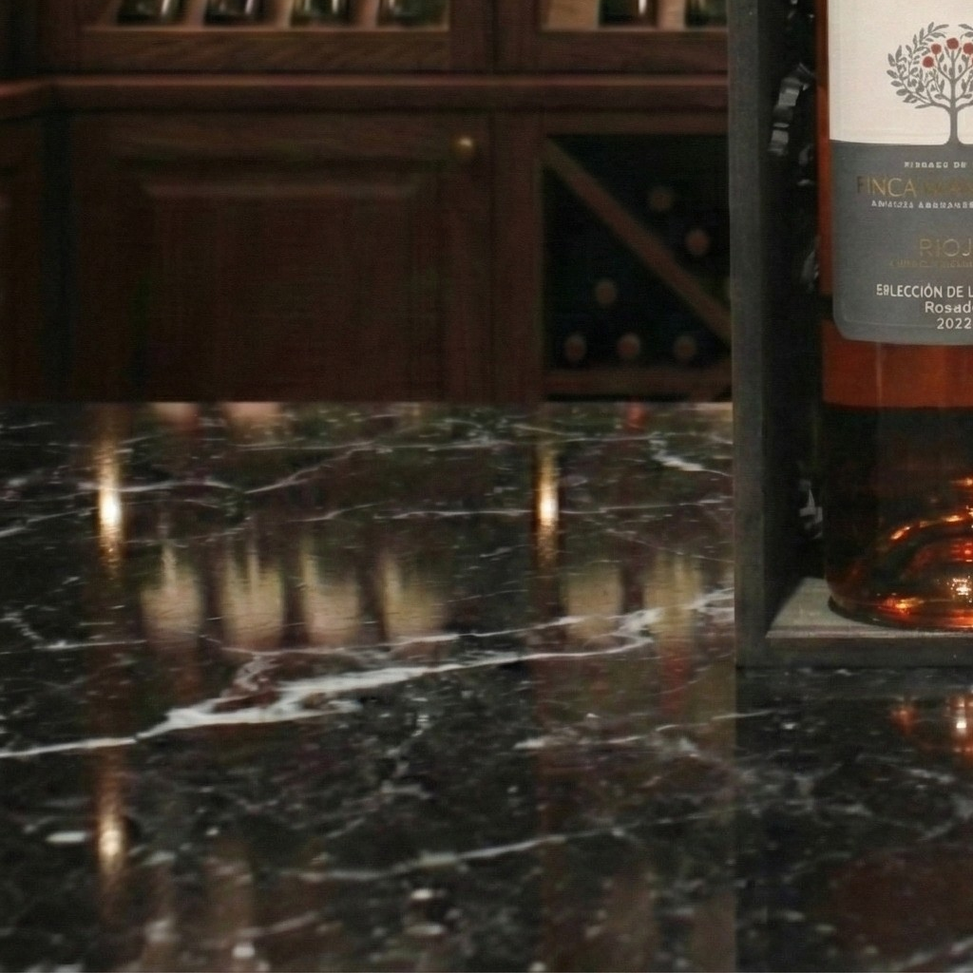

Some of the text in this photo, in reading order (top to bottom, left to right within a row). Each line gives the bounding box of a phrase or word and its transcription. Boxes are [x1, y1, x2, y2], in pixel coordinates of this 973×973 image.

[857, 176, 917, 198] FINCA
[946, 285, 964, 298] DE
[936, 317, 972, 330] 2022
